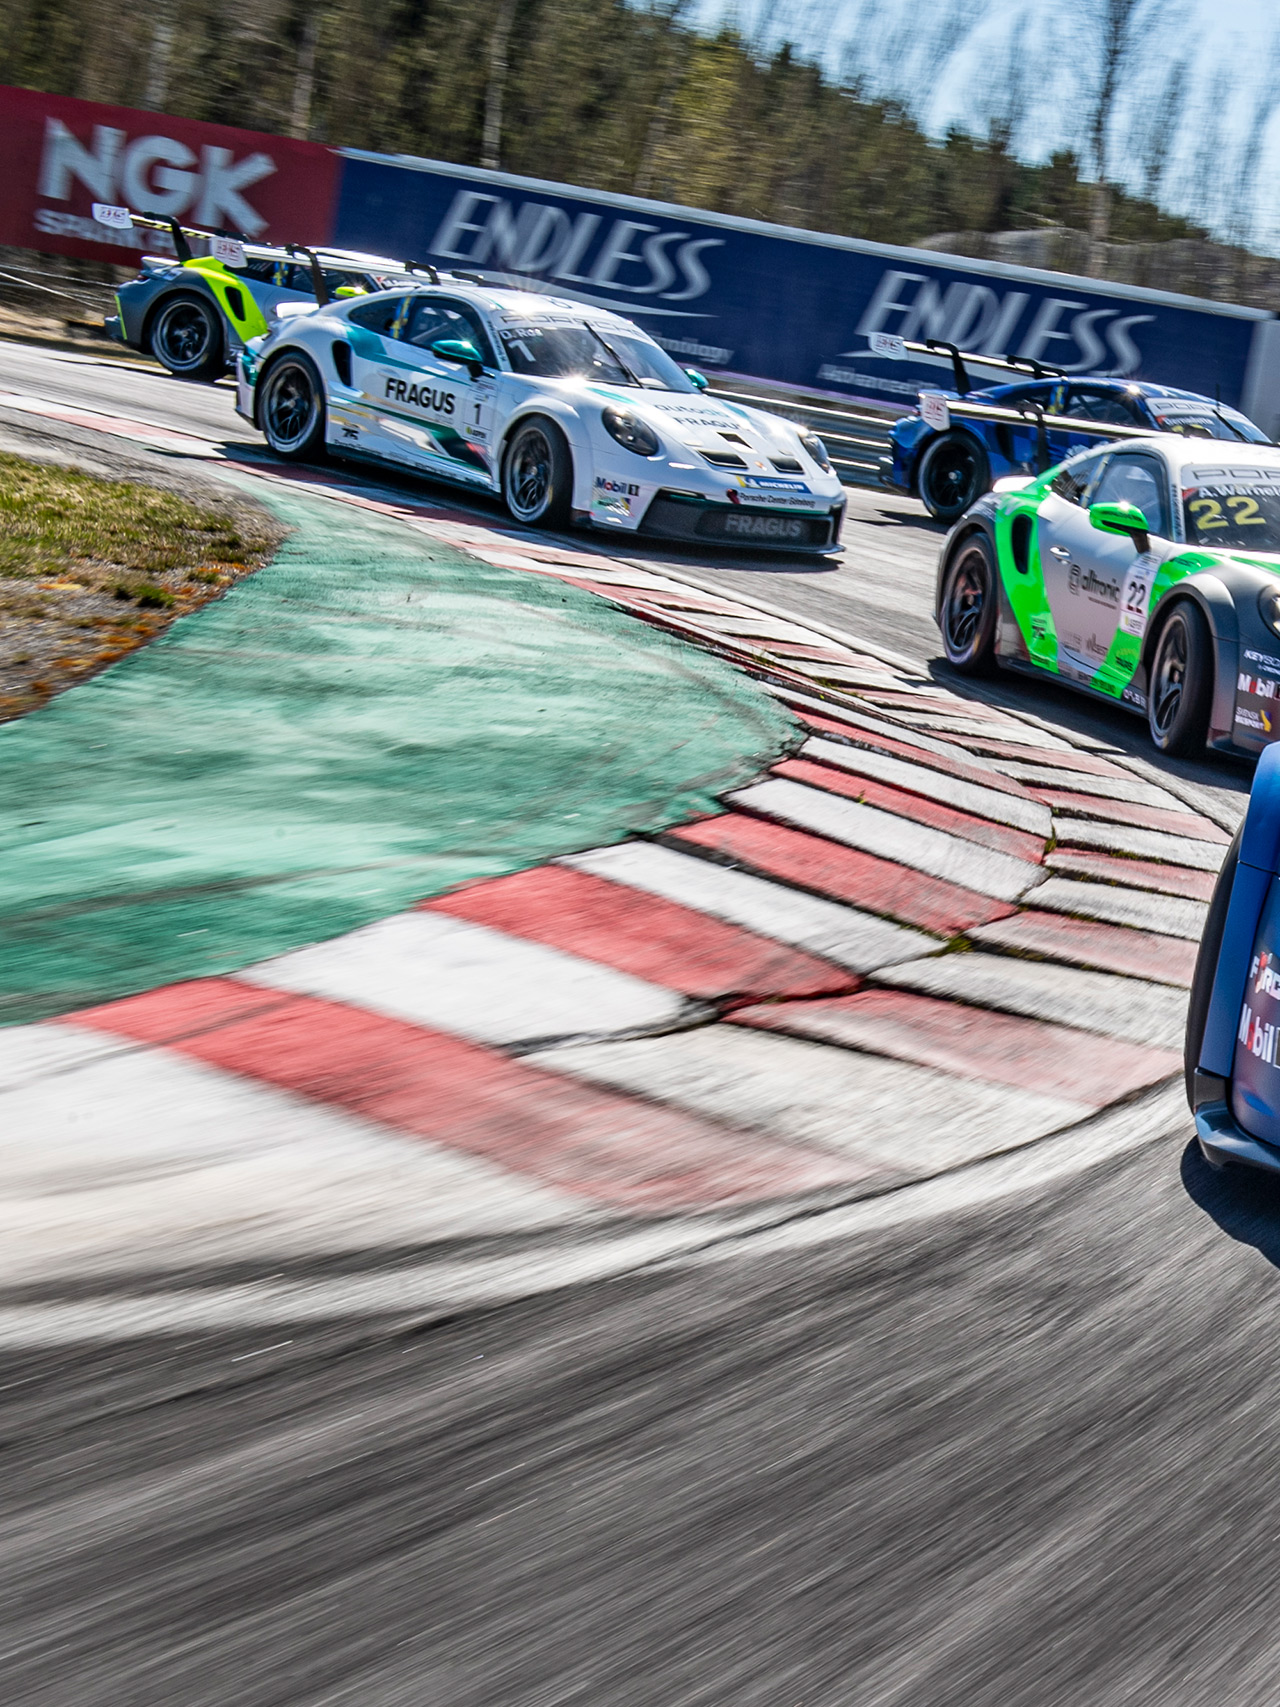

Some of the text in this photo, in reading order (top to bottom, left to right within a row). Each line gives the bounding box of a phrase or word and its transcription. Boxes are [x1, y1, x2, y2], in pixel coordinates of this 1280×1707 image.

[37, 116, 279, 237] NGK
[427, 189, 727, 301] ENDLESS
[855, 269, 1157, 377] ENDLESS
[508, 339, 537, 362] 1
[385, 377, 457, 415] FRAGUS
[473, 402, 482, 425] 1
[673, 416, 748, 432] FRAGU
[596, 476, 627, 494] Mobil
[724, 513, 802, 537] FRAGUS
[1188, 496, 1267, 530] 22
[1128, 580, 1147, 614] 22
[1237, 672, 1275, 699] Mobil
[1238, 1002, 1275, 1064] Mobil
